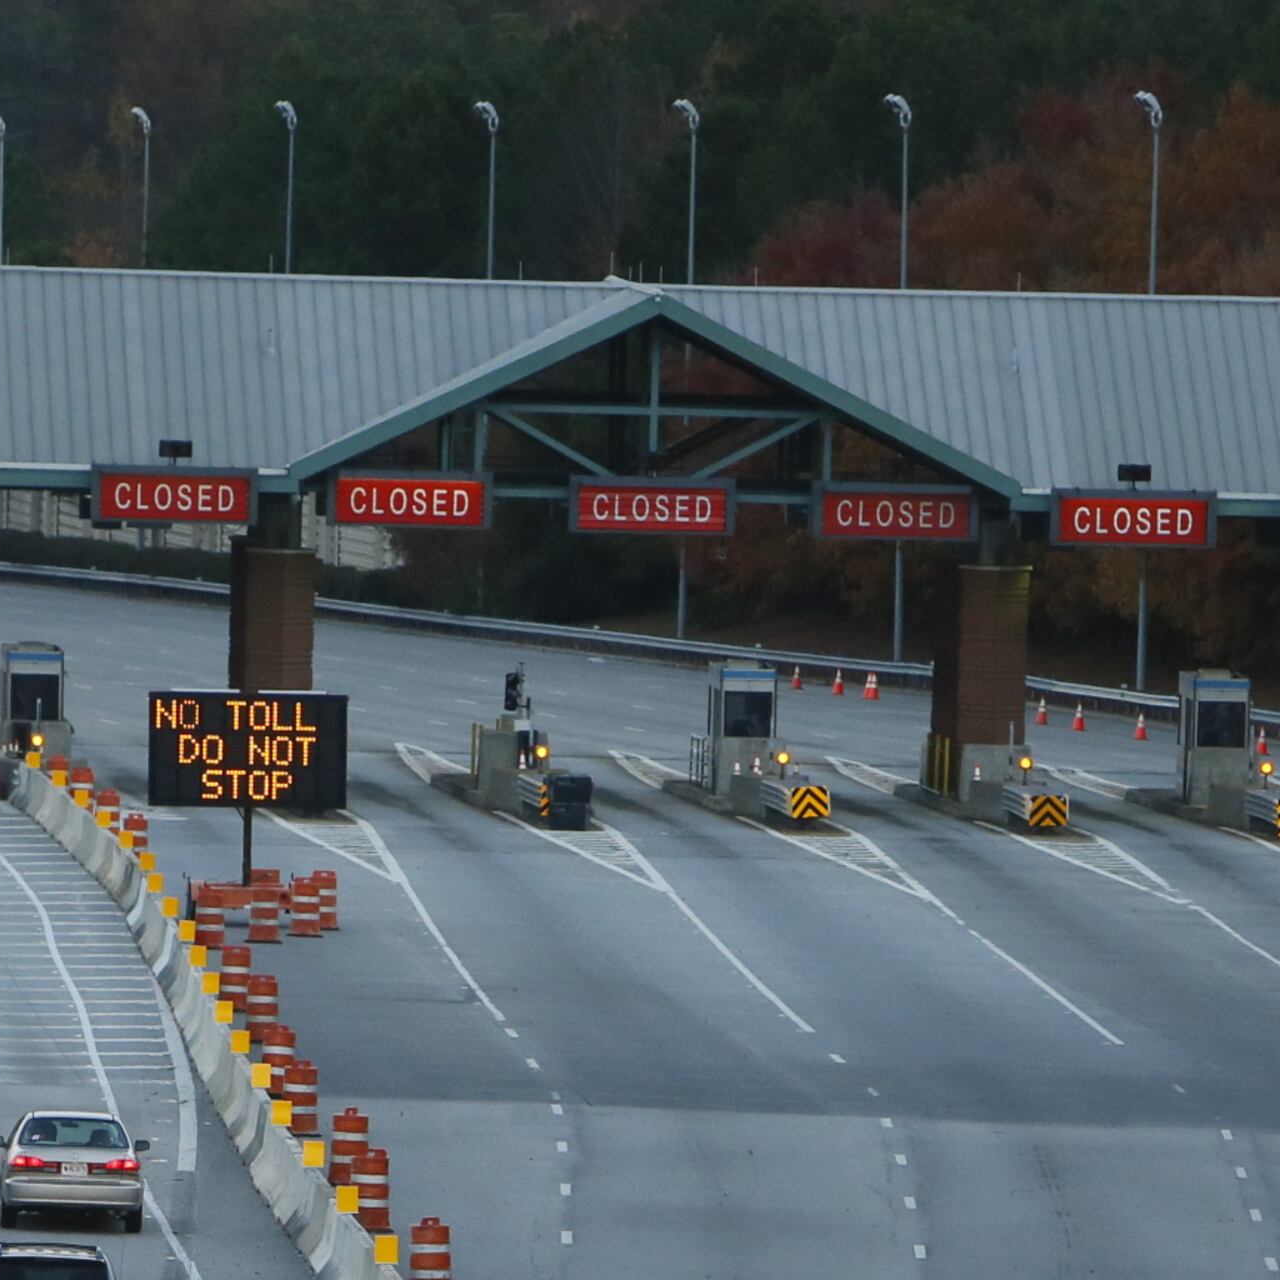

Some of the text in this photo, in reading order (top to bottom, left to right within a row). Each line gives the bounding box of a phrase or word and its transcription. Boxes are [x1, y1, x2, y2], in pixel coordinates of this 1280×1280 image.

[115, 482, 234, 512] CLOSED
[350, 487, 469, 516] CLOSED
[593, 494, 712, 523] CLOSED
[836, 499, 956, 528] CLOSED
[1074, 506, 1193, 535] CLOSED
[155, 699, 317, 732] NO TOLL
[178, 734, 317, 766] DO NOT
[201, 769, 293, 800] STOP
